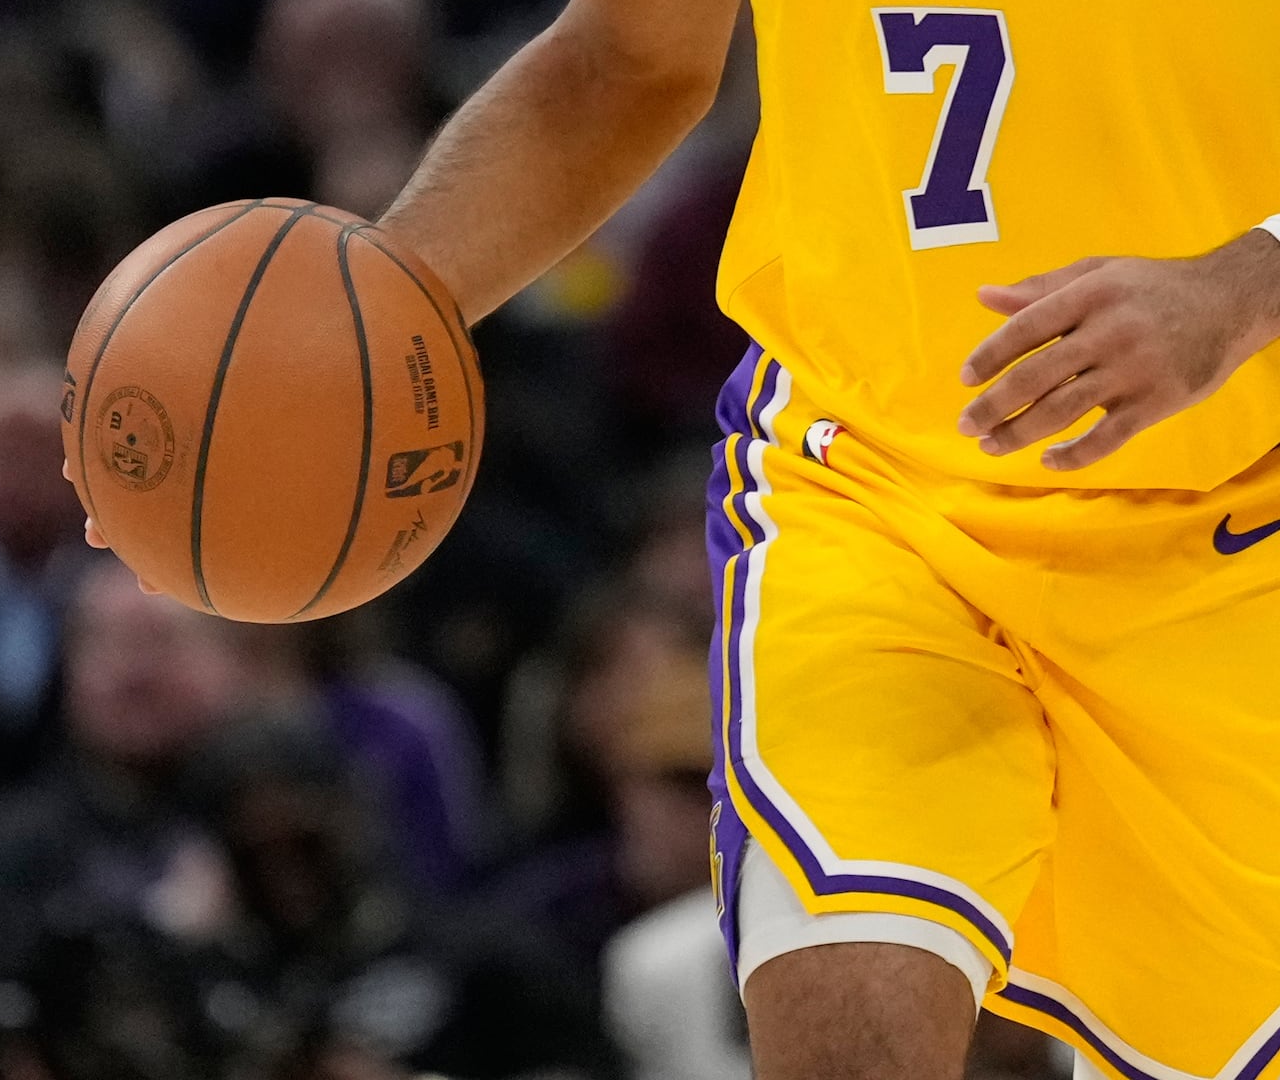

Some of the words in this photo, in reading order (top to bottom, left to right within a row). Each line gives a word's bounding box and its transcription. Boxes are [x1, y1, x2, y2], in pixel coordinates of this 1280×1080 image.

[871, 6, 1015, 250] 7
[411, 335, 432, 375] OFFICIAL
[423, 378, 438, 404] GAME
[427, 406, 440, 432] BALL
